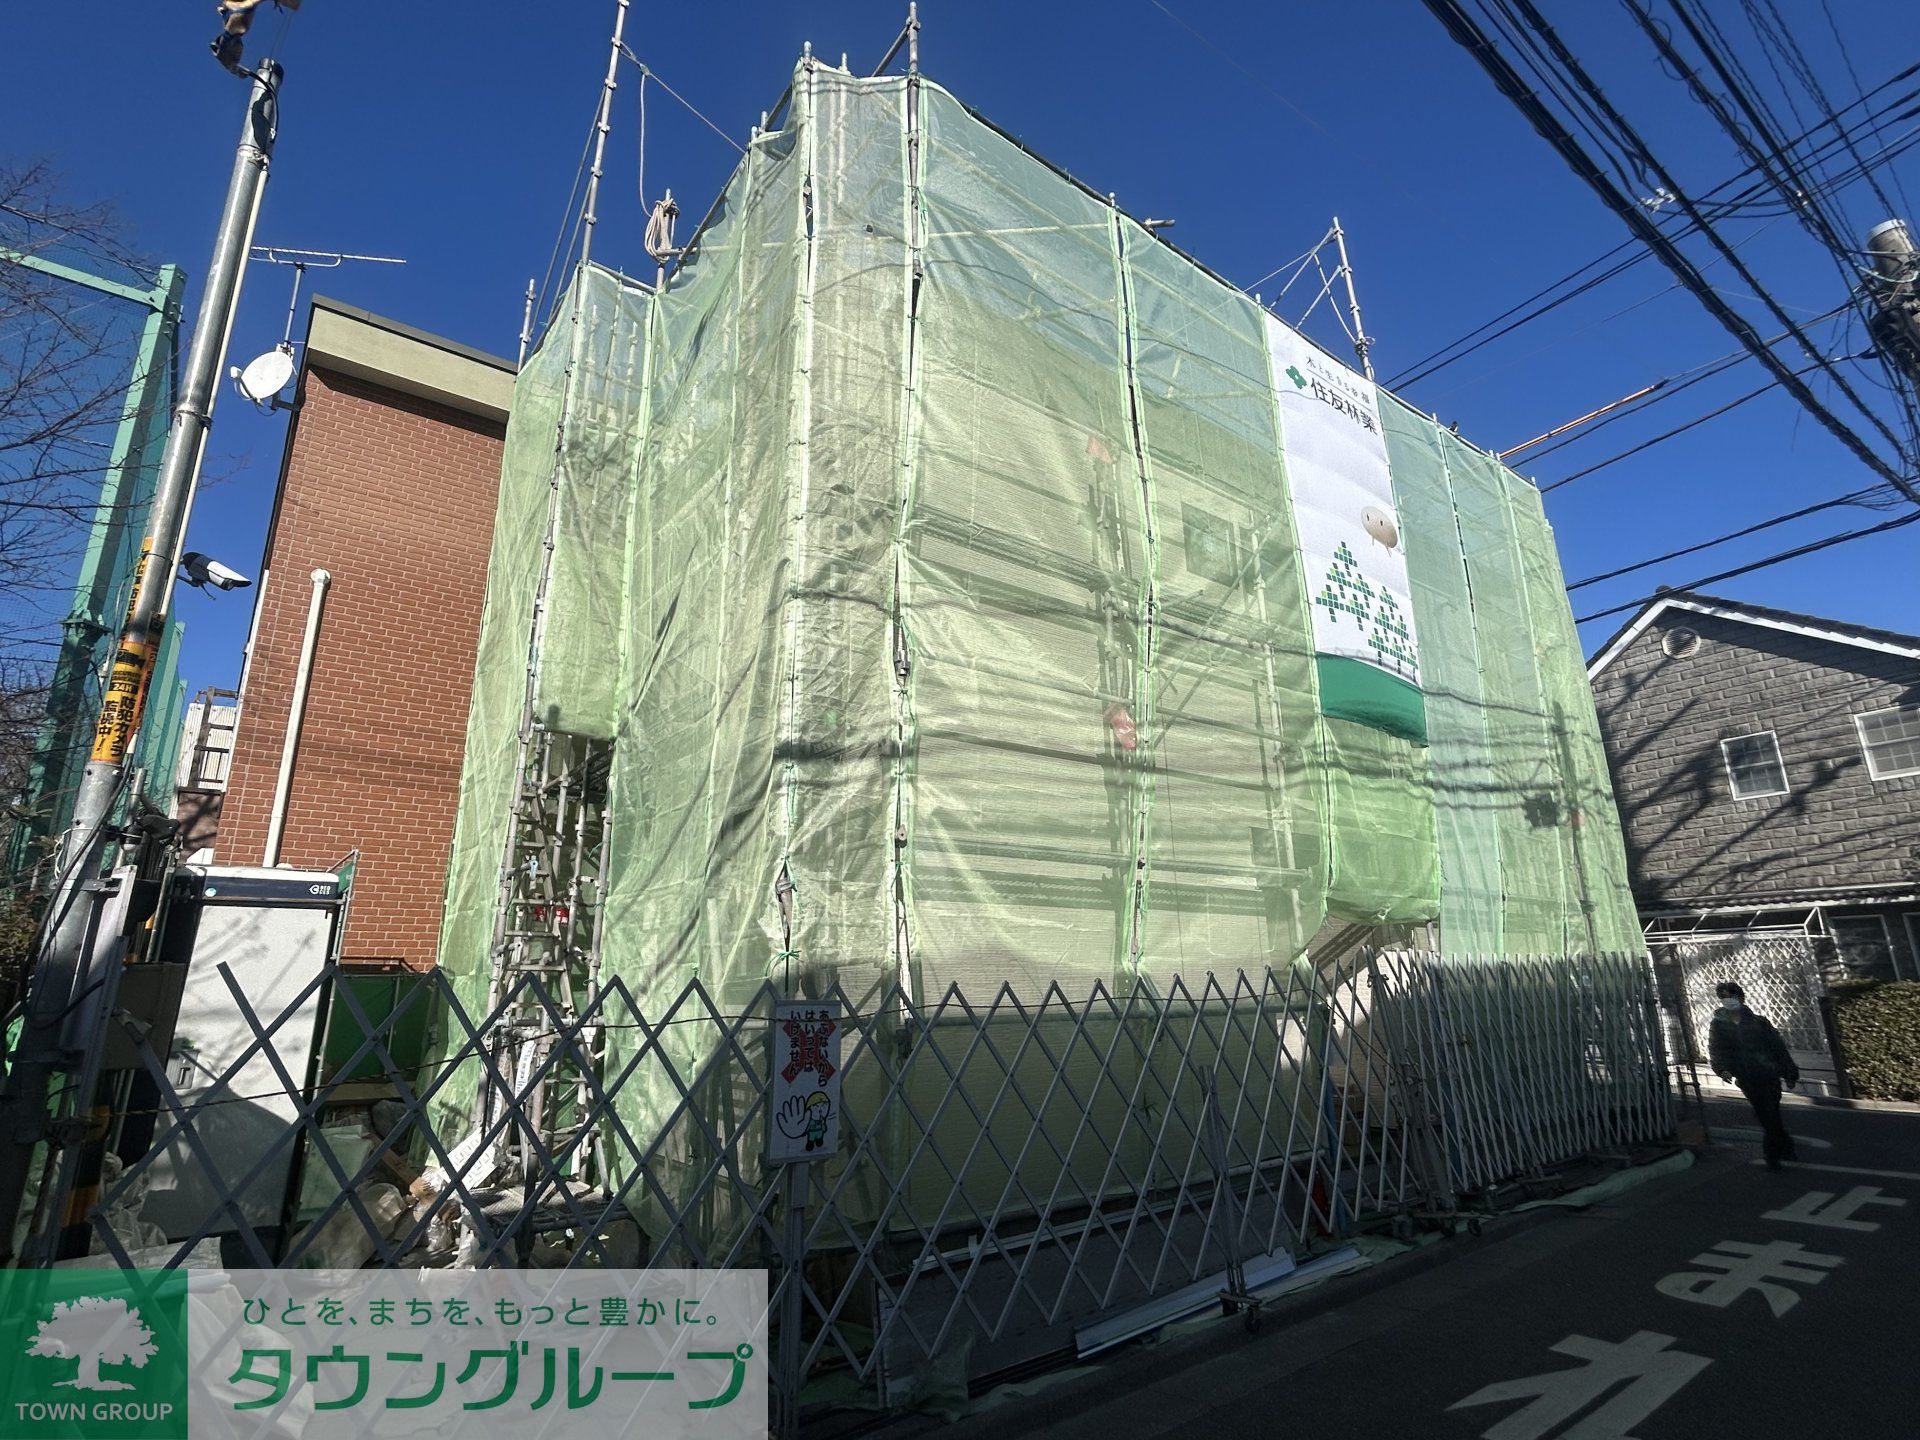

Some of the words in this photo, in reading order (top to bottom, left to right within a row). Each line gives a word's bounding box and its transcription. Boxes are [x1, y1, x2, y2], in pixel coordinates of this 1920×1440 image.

[1310, 377, 1378, 436] 住友林業
[112, 683, 133, 693] 24H
[110, 696, 136, 757] 防犯カメラ
[789, 1010, 801, 1075] いけません
[804, 1010, 816, 1073] はいっては
[818, 1010, 830, 1087] あぶないから
